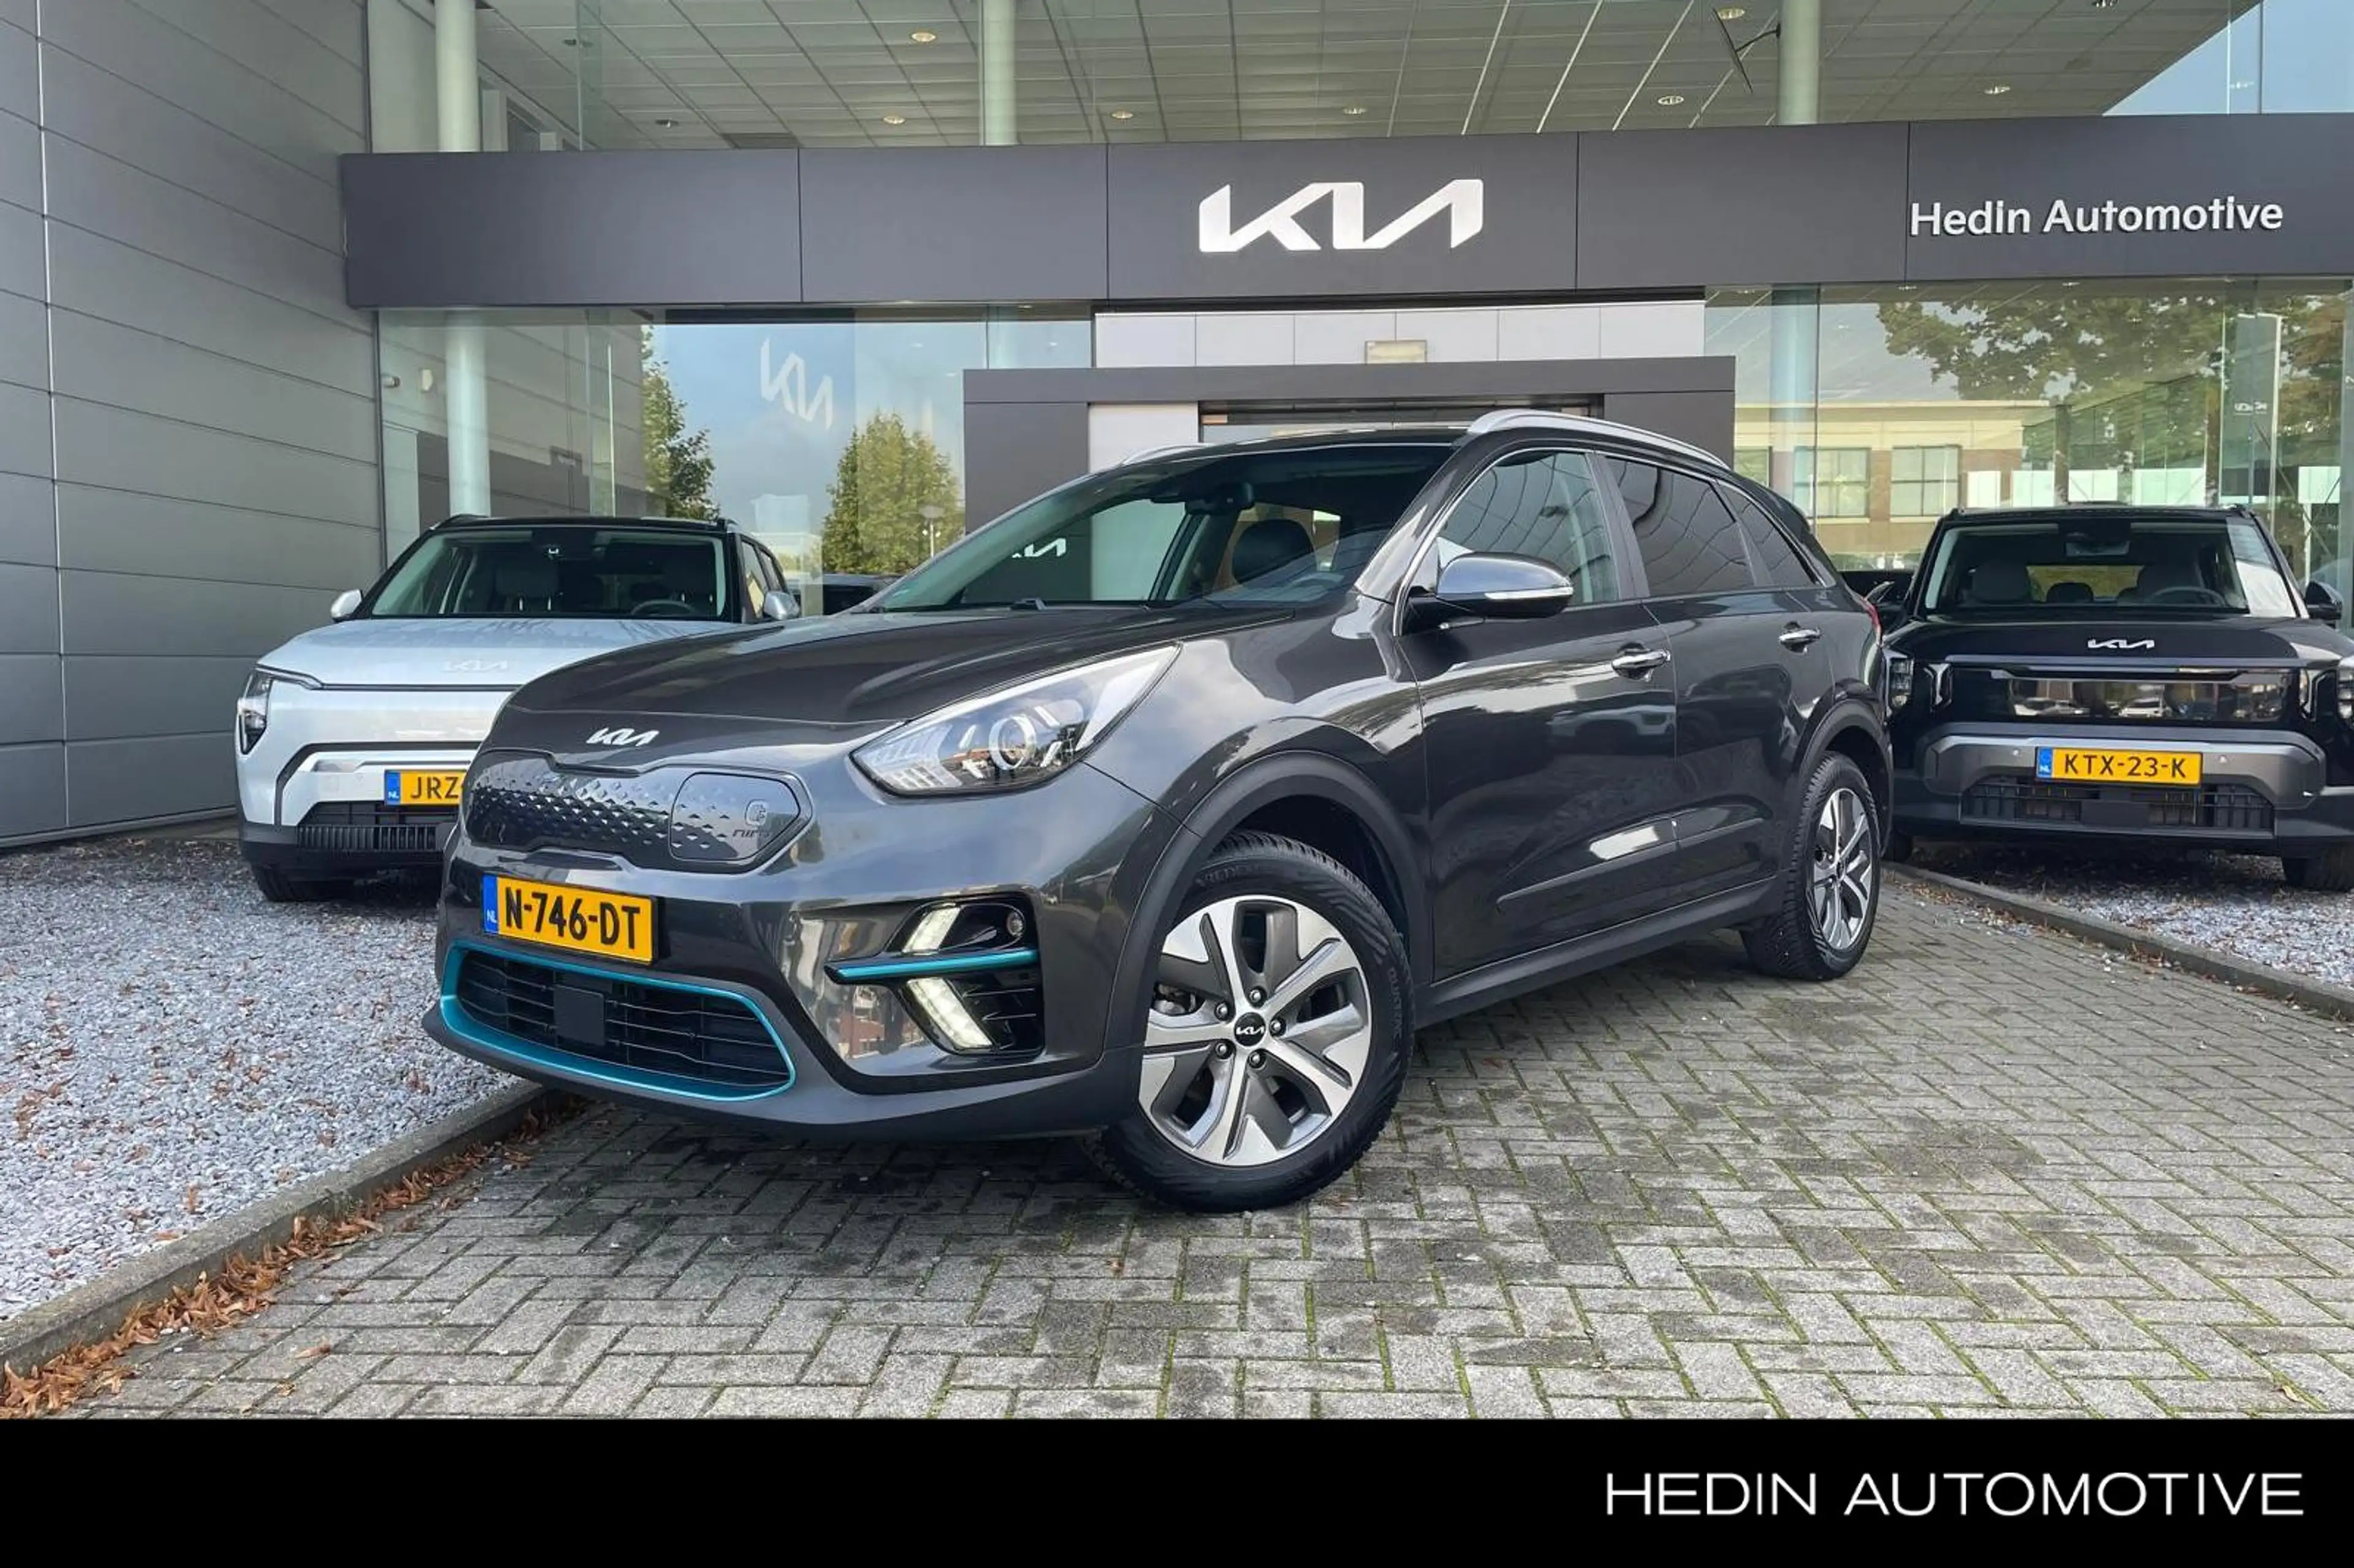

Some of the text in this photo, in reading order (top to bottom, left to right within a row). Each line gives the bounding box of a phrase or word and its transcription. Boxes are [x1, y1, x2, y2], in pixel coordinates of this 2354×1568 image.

[1199, 179, 1484, 252] KIA
[1910, 196, 2284, 235] Hedin Automotive
[2087, 639, 2155, 649] KIA
[442, 660, 508, 672] KIA
[585, 727, 660, 747] KIA
[2064, 753, 2186, 778] KTX-23-K
[486, 887, 641, 950] NL N-746-DT
[1236, 1026, 1265, 1035] KIA
